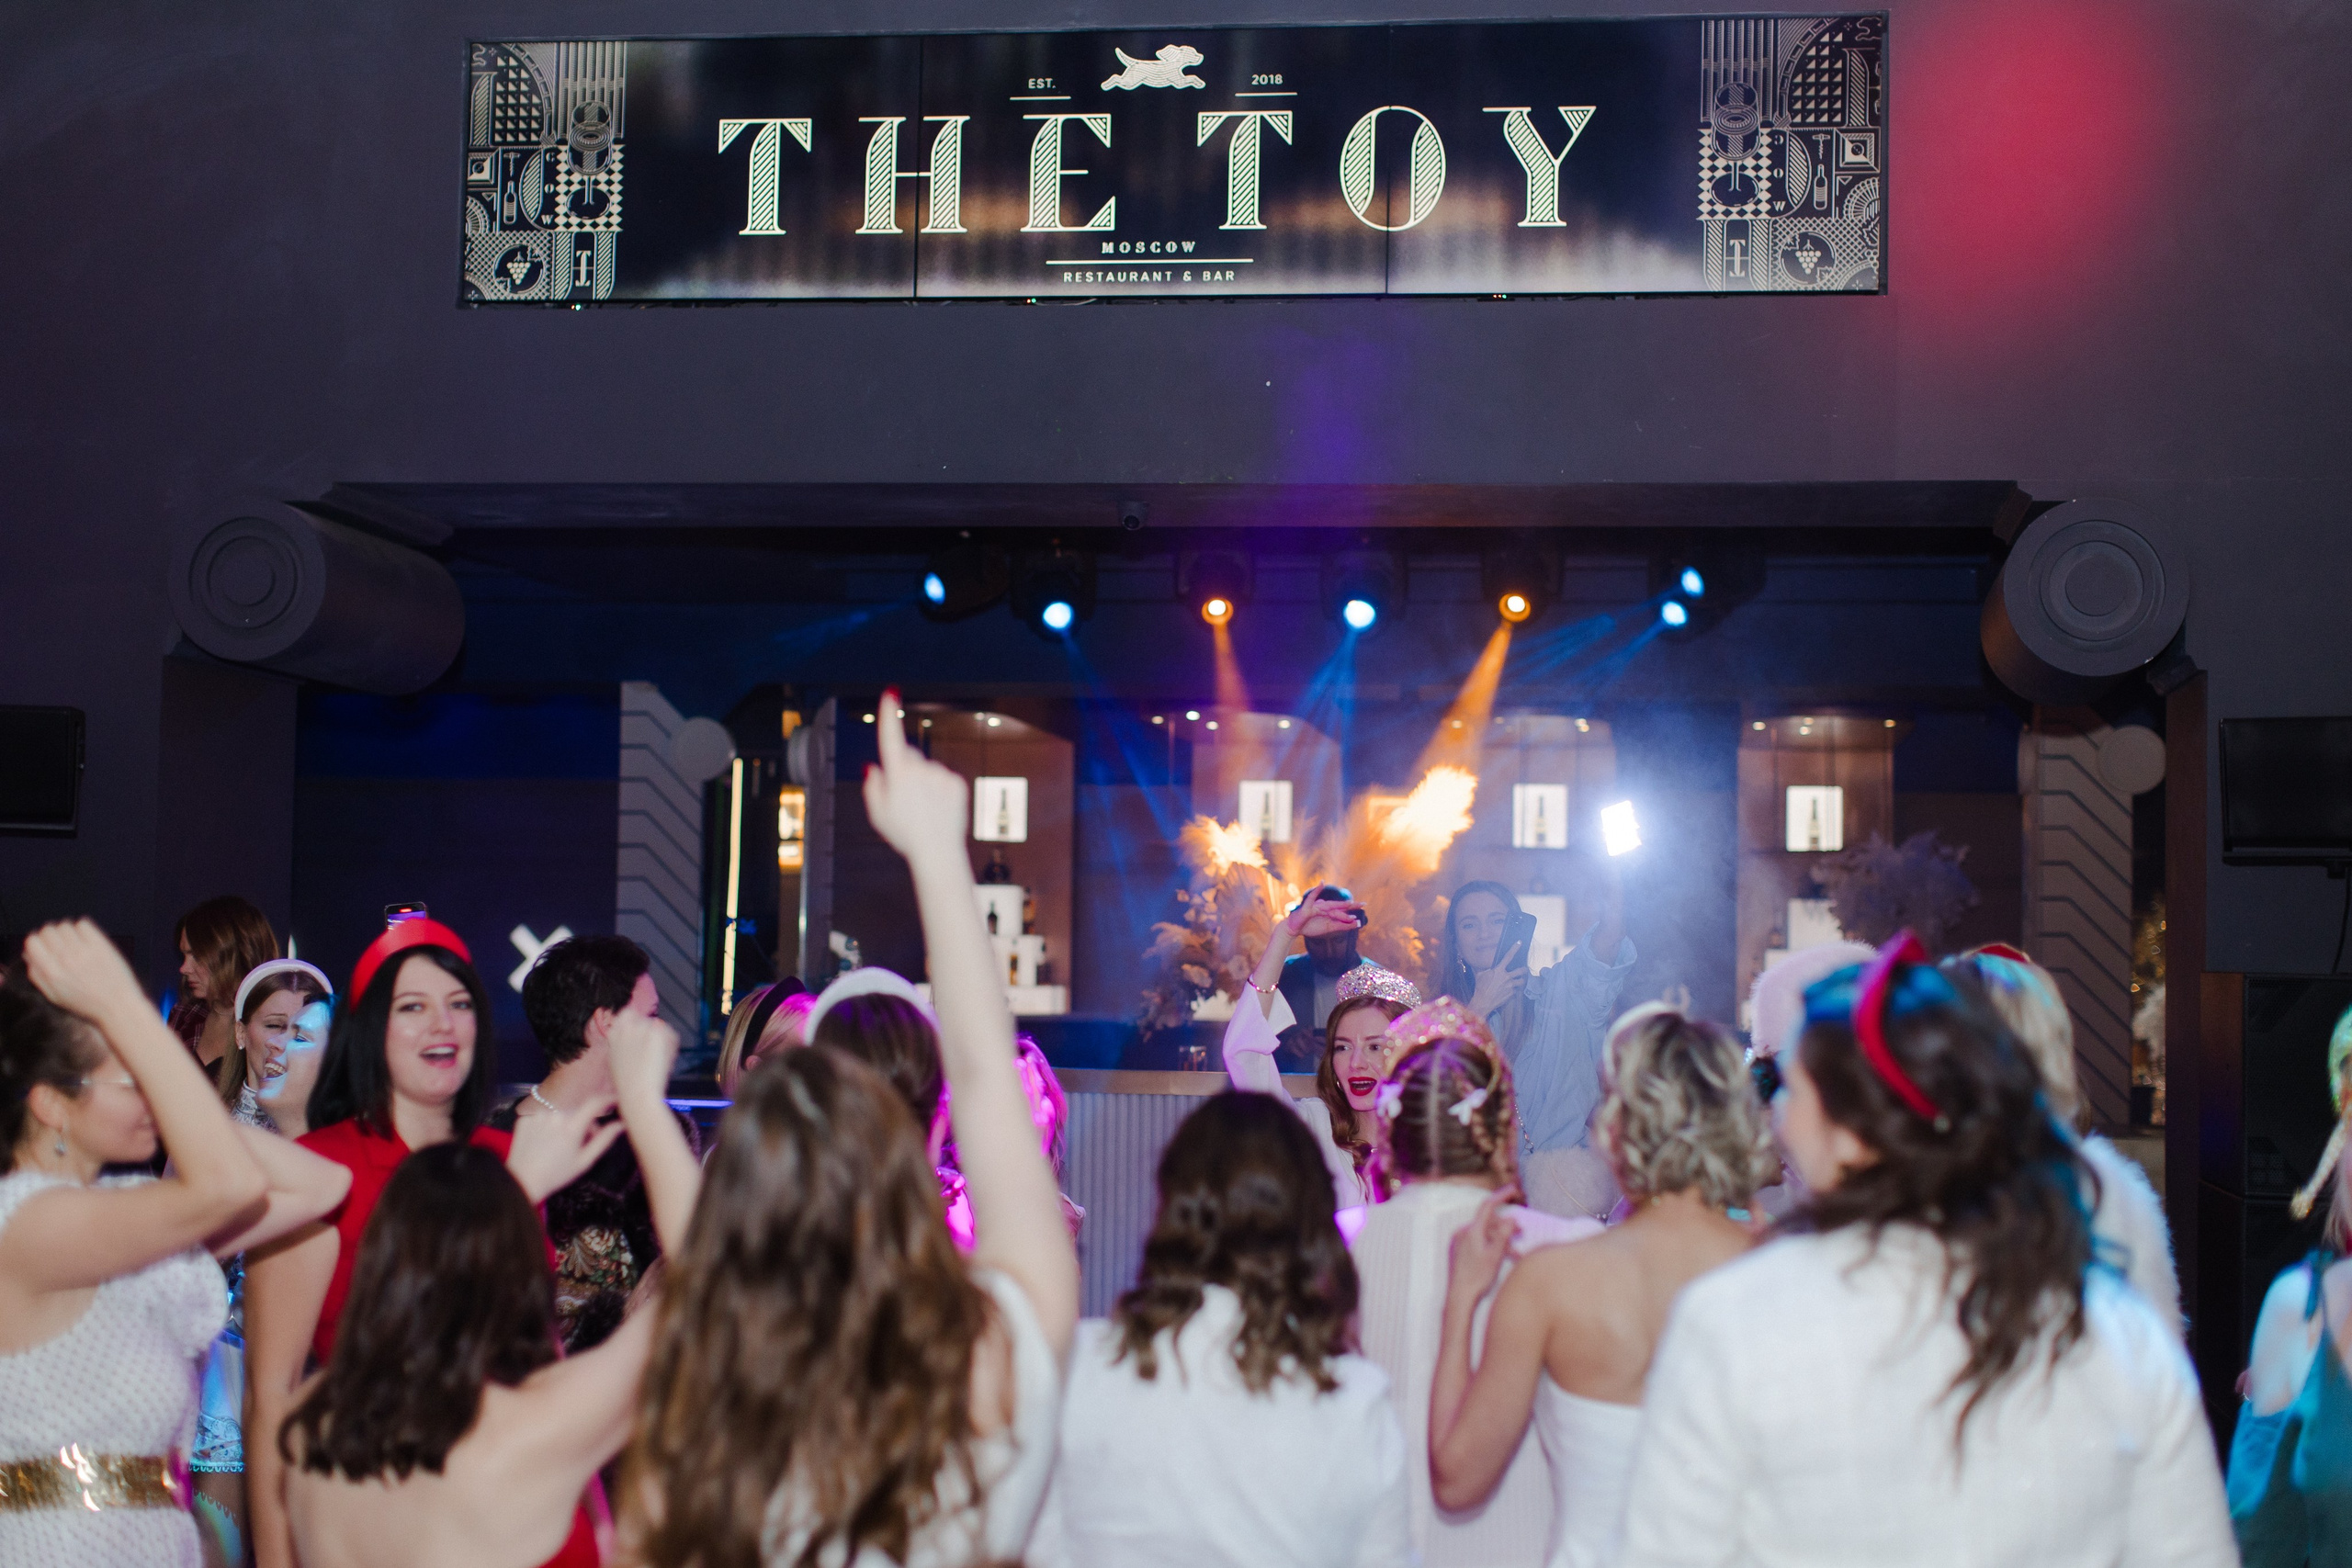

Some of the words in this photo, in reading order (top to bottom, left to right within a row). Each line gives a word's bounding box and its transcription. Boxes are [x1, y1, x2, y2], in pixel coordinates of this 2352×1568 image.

[1028, 78, 1056, 89] EST.
[1251, 73, 1283, 85] 2018
[718, 113, 1116, 235] THE
[1196, 106, 1597, 231] TOY
[1101, 241, 1196, 254] MOSCOW
[1063, 271, 1172, 283] RESTAURANT
[1182, 270, 1193, 282] &
[1202, 270, 1235, 282] BAR
